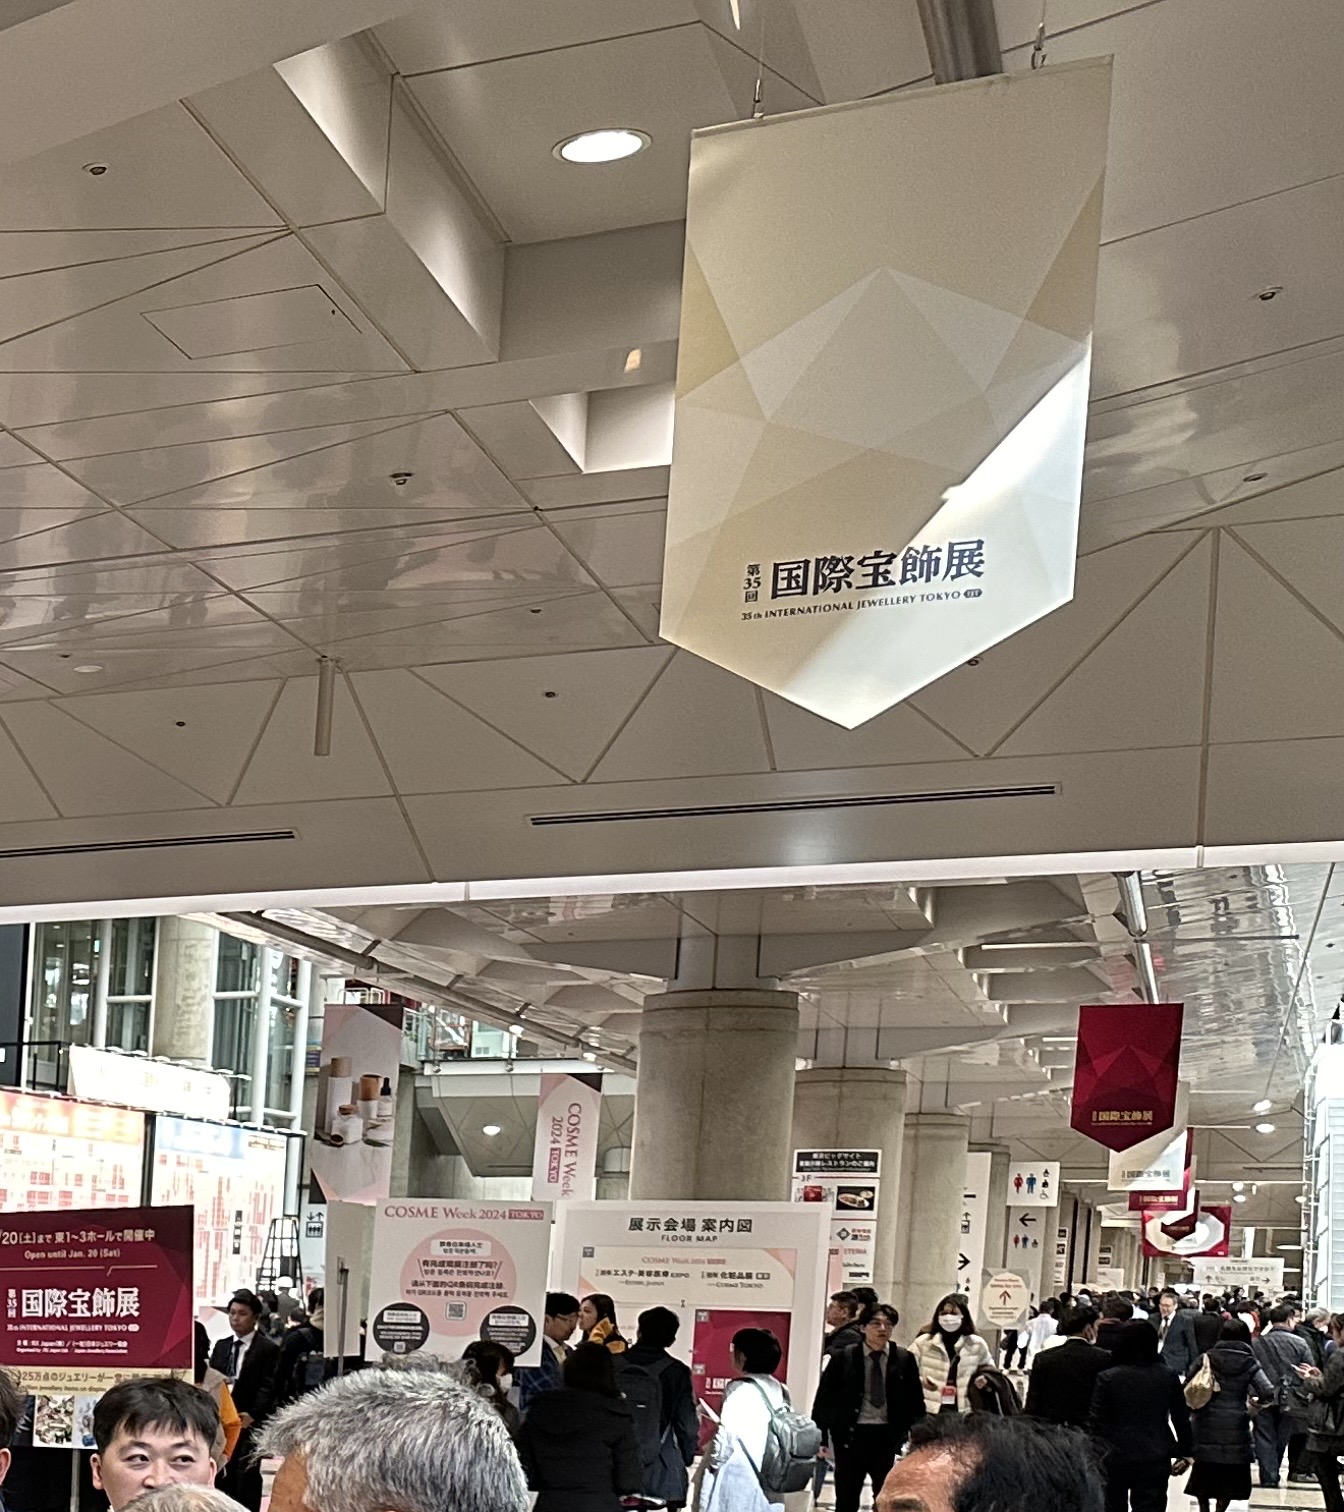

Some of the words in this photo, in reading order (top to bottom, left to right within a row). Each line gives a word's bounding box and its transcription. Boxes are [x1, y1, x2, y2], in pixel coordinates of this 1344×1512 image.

[771, 539, 985, 599] 国際宝飾展
[764, 602, 854, 619] INTERNATIONAL
[856, 595, 917, 610] JEWELLERY
[919, 590, 961, 602] TOKYO
[550, 1116, 564, 1145] 2024
[564, 1102, 582, 1158] COSME
[561, 1161, 577, 1197] Week
[384, 1205, 439, 1219] COSME
[442, 1206, 477, 1219] Week
[478, 1209, 507, 1220] 2024
[24, 1250, 46, 1260] Open
[48, 1249, 67, 1258] until
[88, 1249, 98, 1258] 20
[21, 1287, 140, 1318] 国際宝飾展
